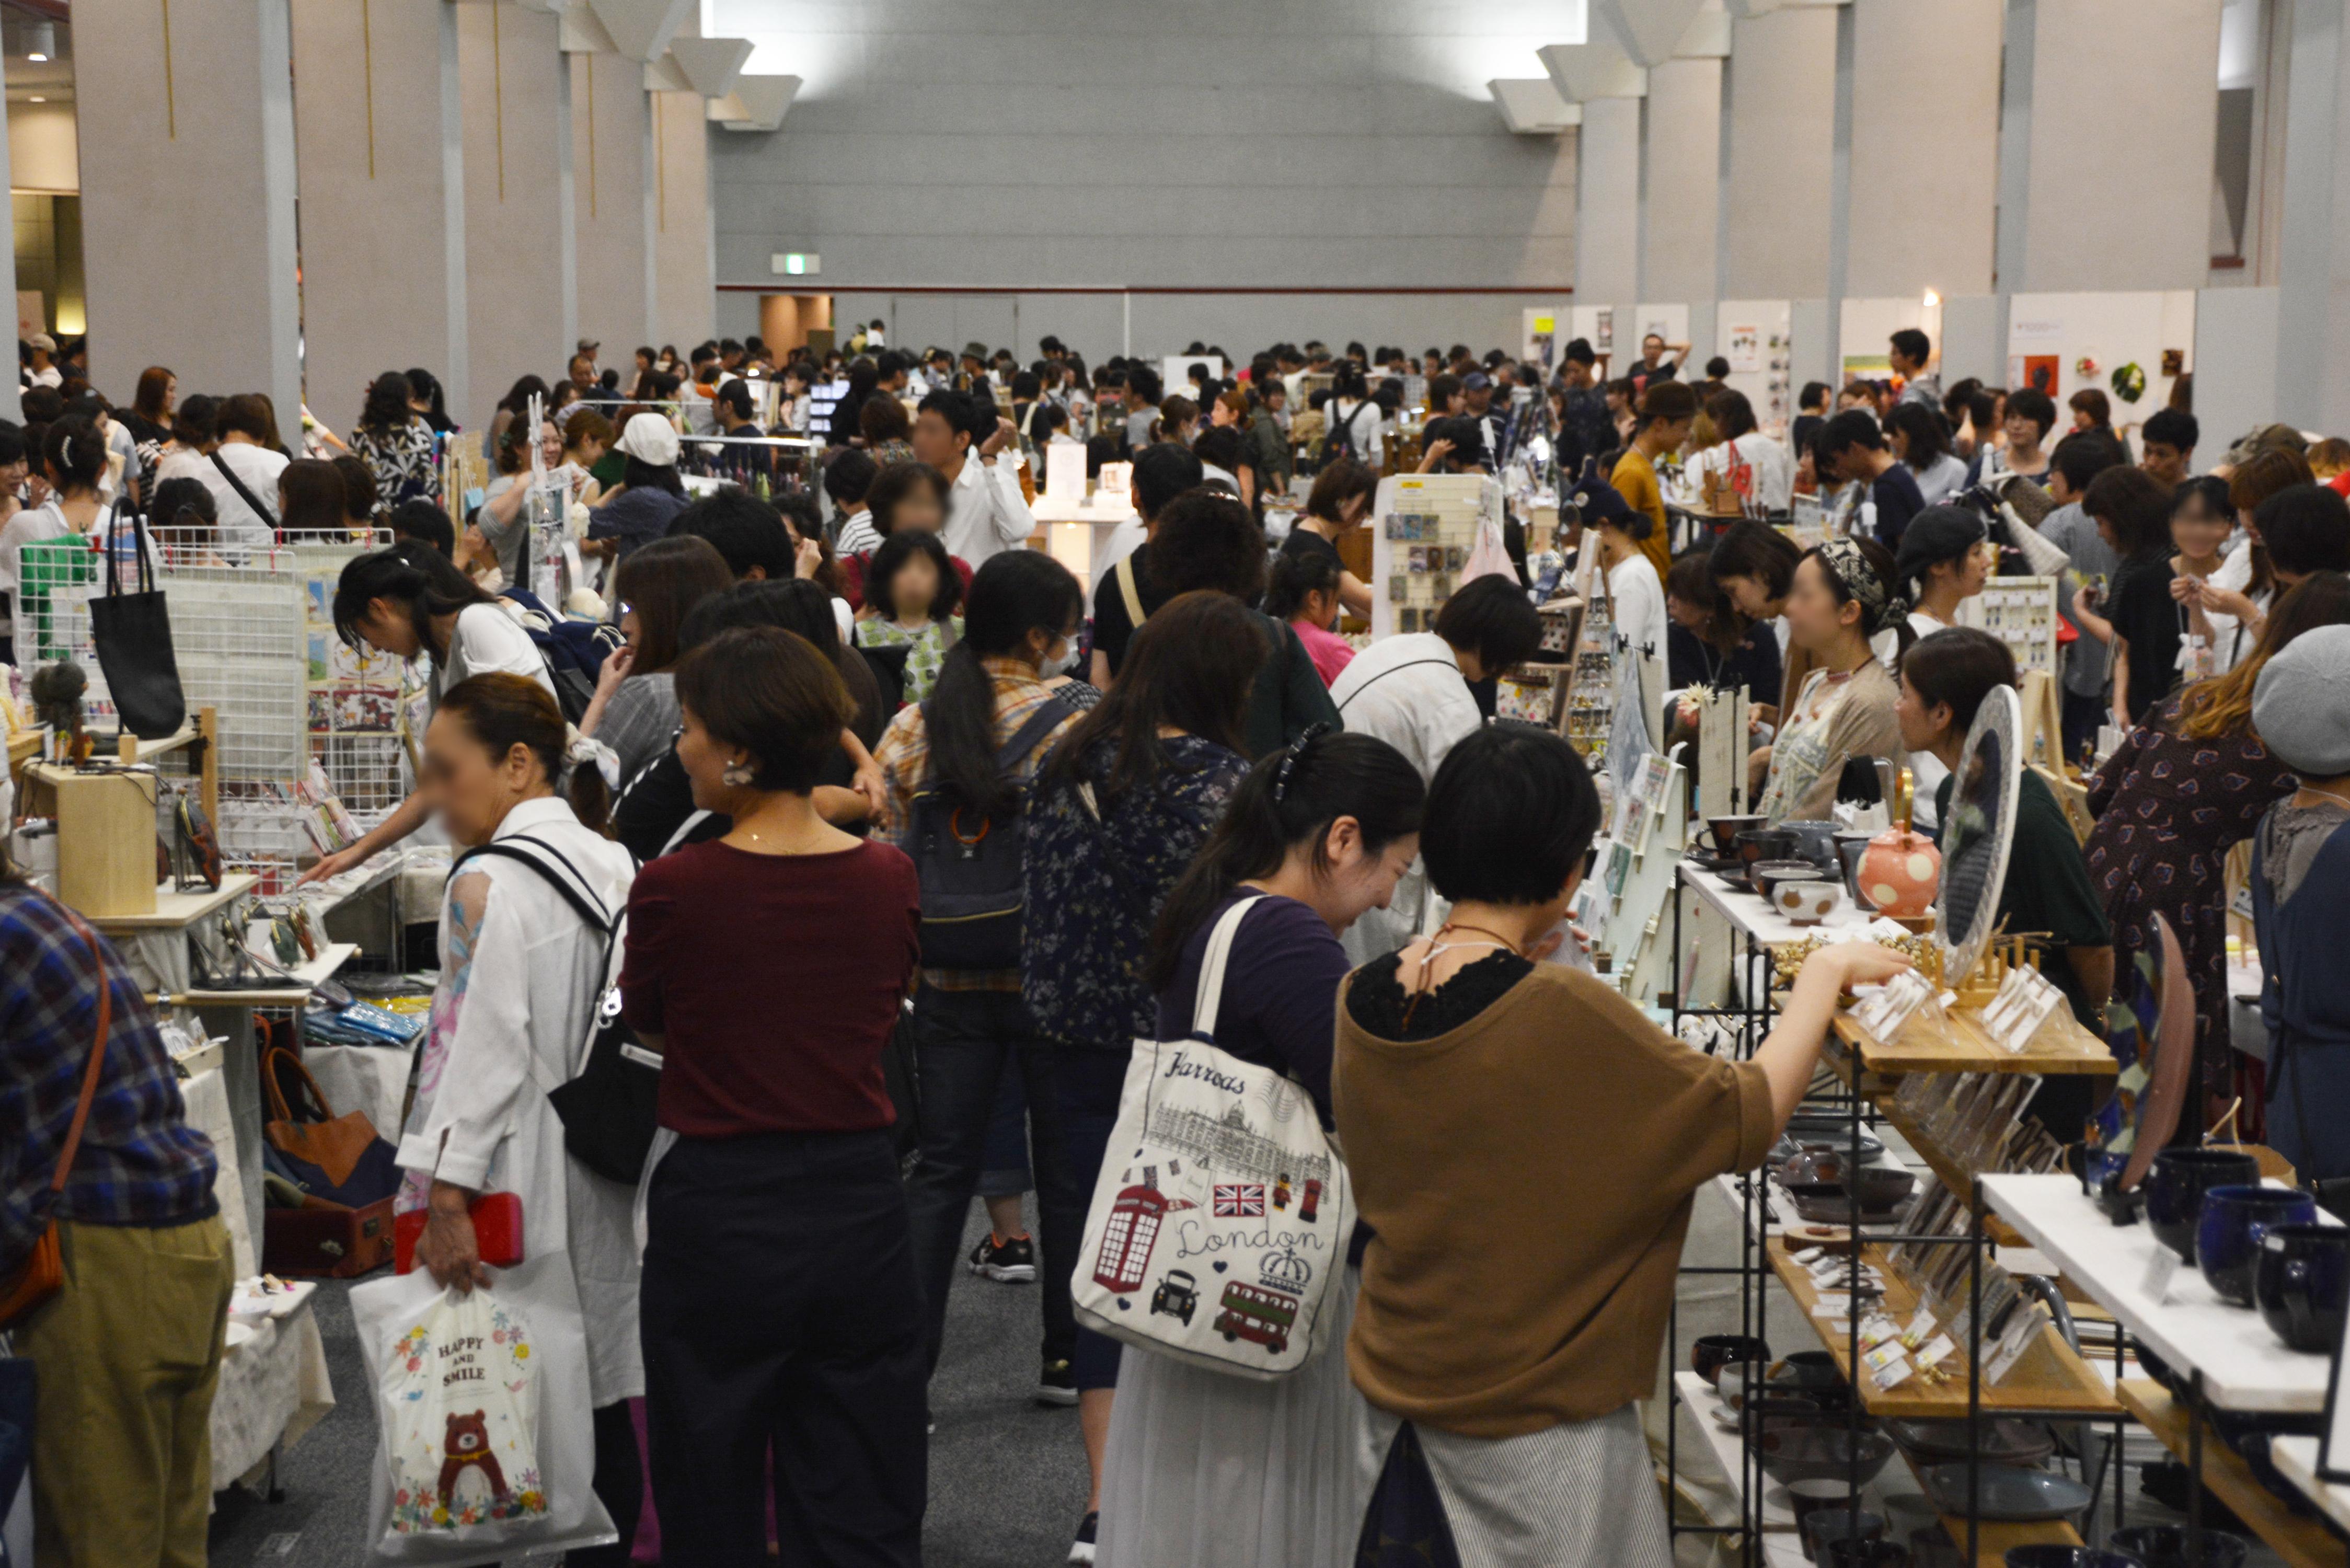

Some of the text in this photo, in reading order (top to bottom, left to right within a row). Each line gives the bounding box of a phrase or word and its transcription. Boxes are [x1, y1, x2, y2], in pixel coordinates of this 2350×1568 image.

[1177, 1214, 1324, 1259] London
[439, 1337, 484, 1358] HAPPY
[453, 1353, 474, 1366] AND
[443, 1368, 485, 1387] SMILE
